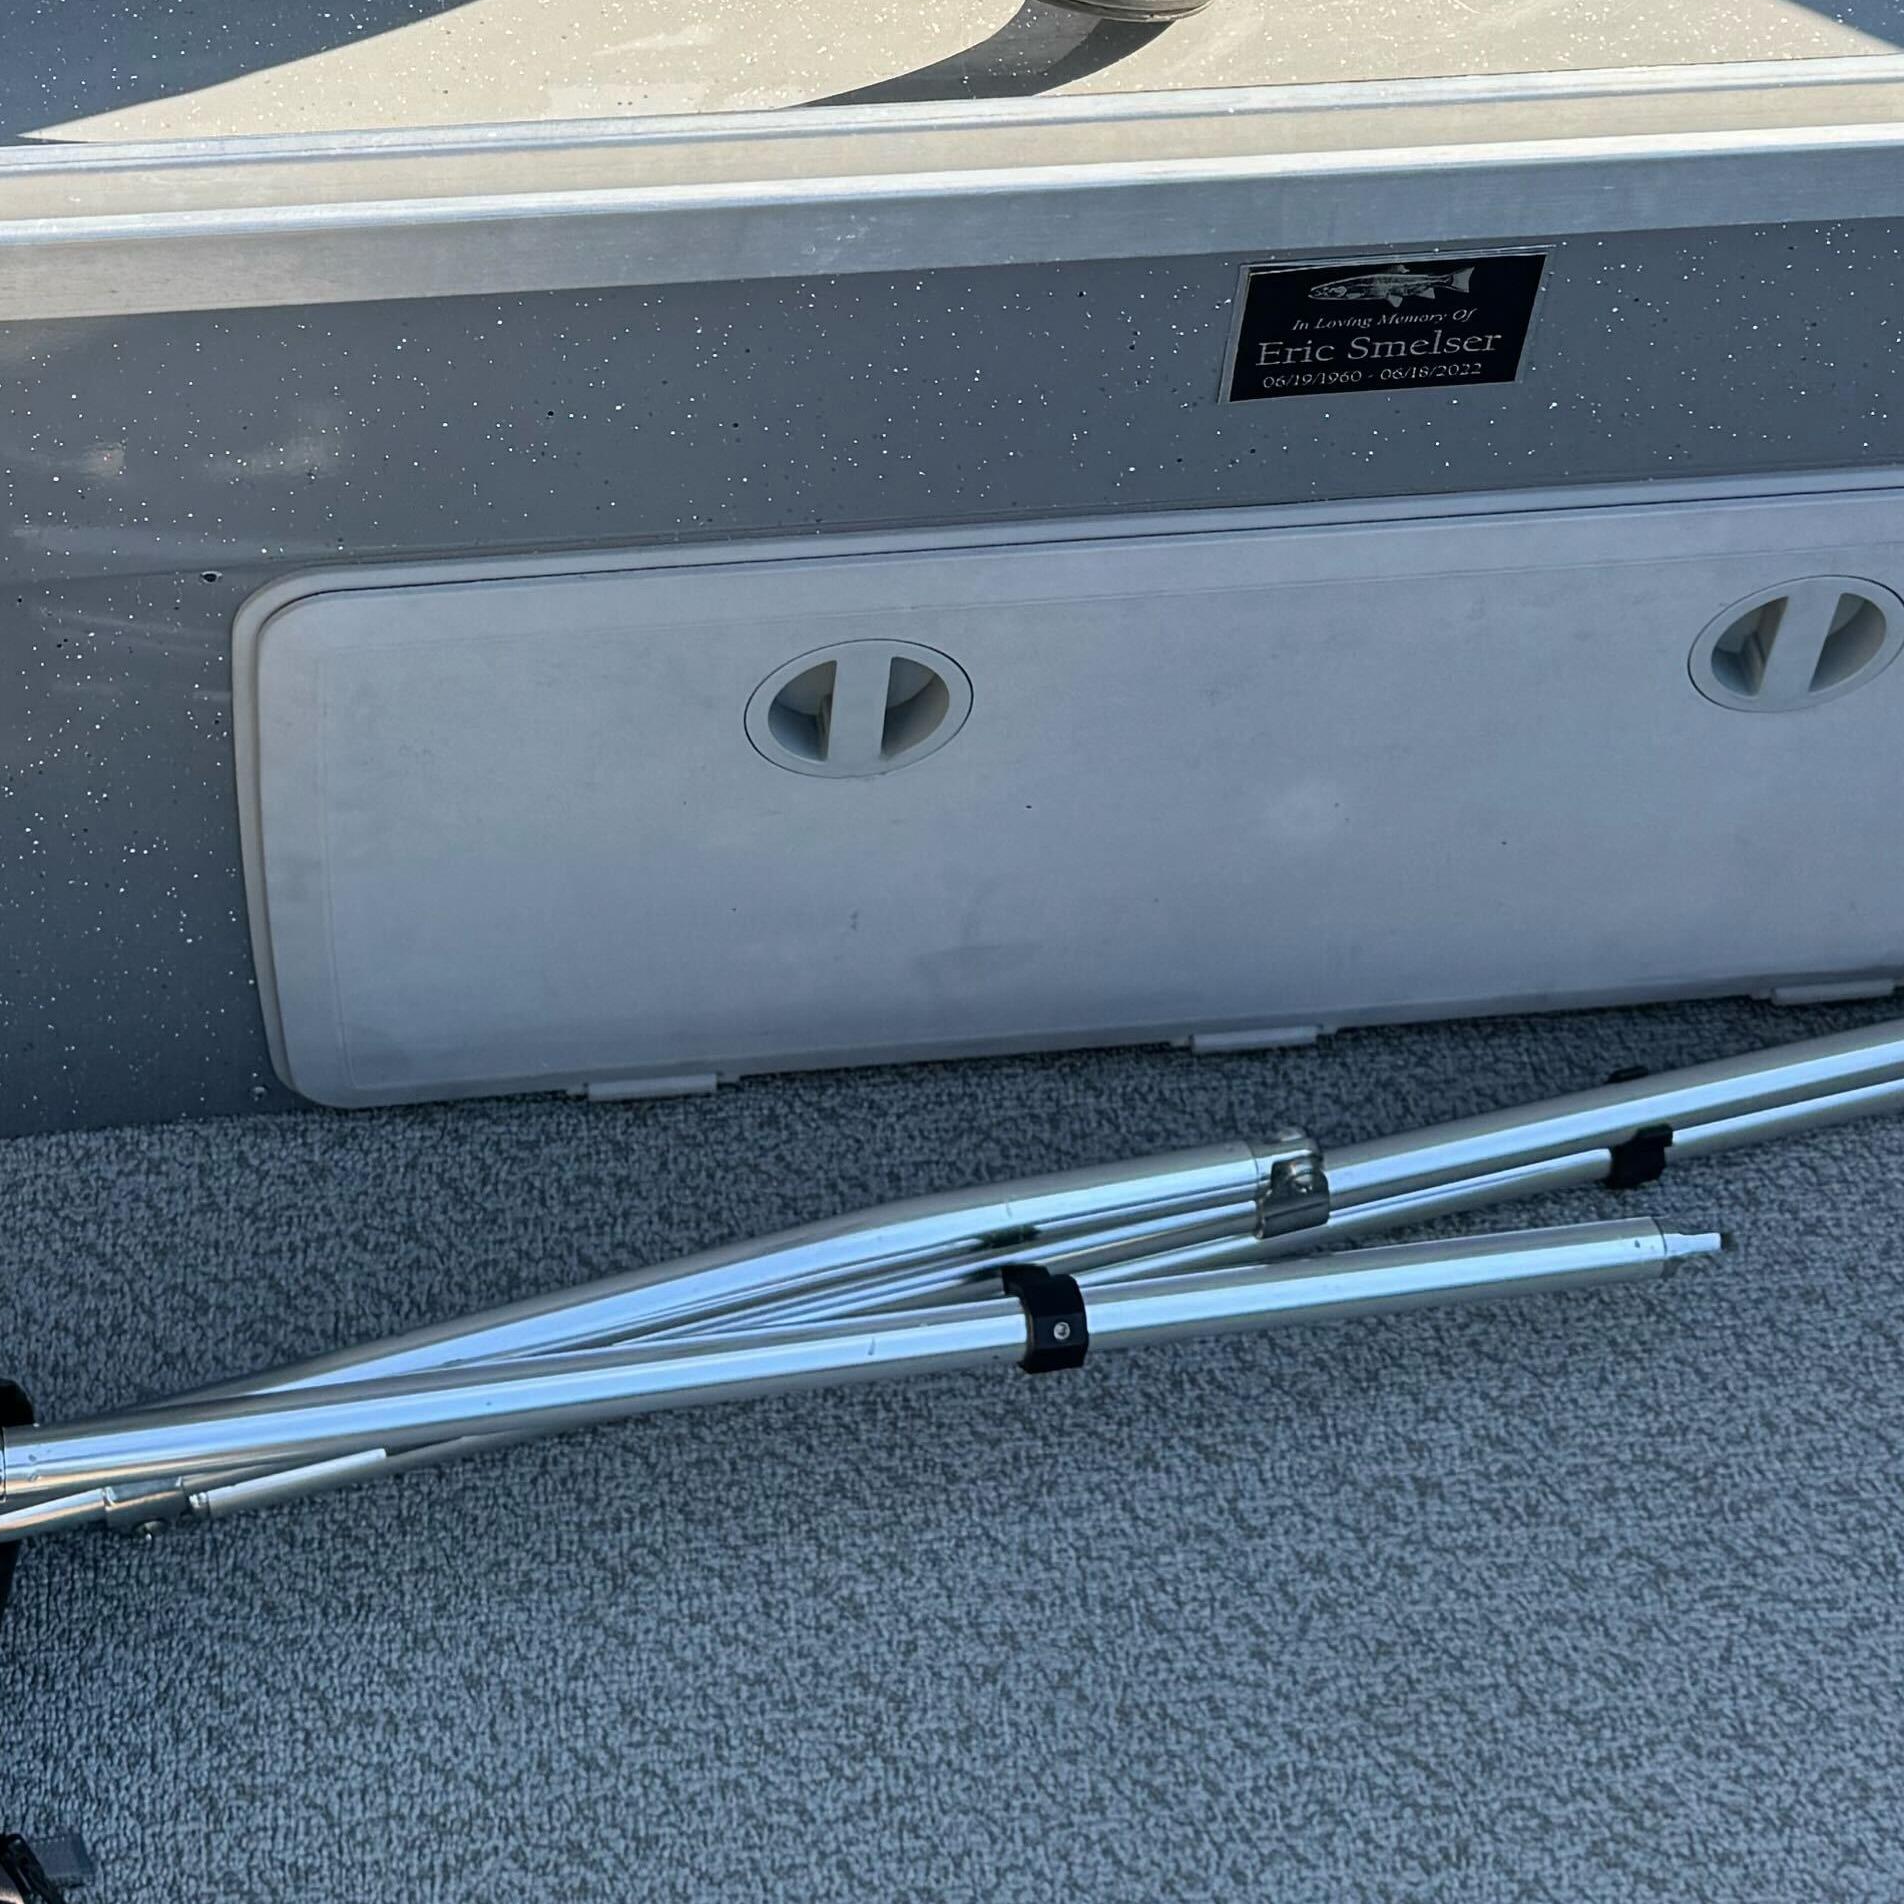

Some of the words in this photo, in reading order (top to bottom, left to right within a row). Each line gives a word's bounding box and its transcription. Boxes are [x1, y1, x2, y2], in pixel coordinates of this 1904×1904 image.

[1292, 319, 1309, 331] In
[1314, 316, 1373, 330] Loving
[1377, 312, 1447, 327] Memory
[1451, 307, 1478, 323] Of
[1256, 340, 1335, 366] Eric
[1347, 329, 1502, 360] Smelser
